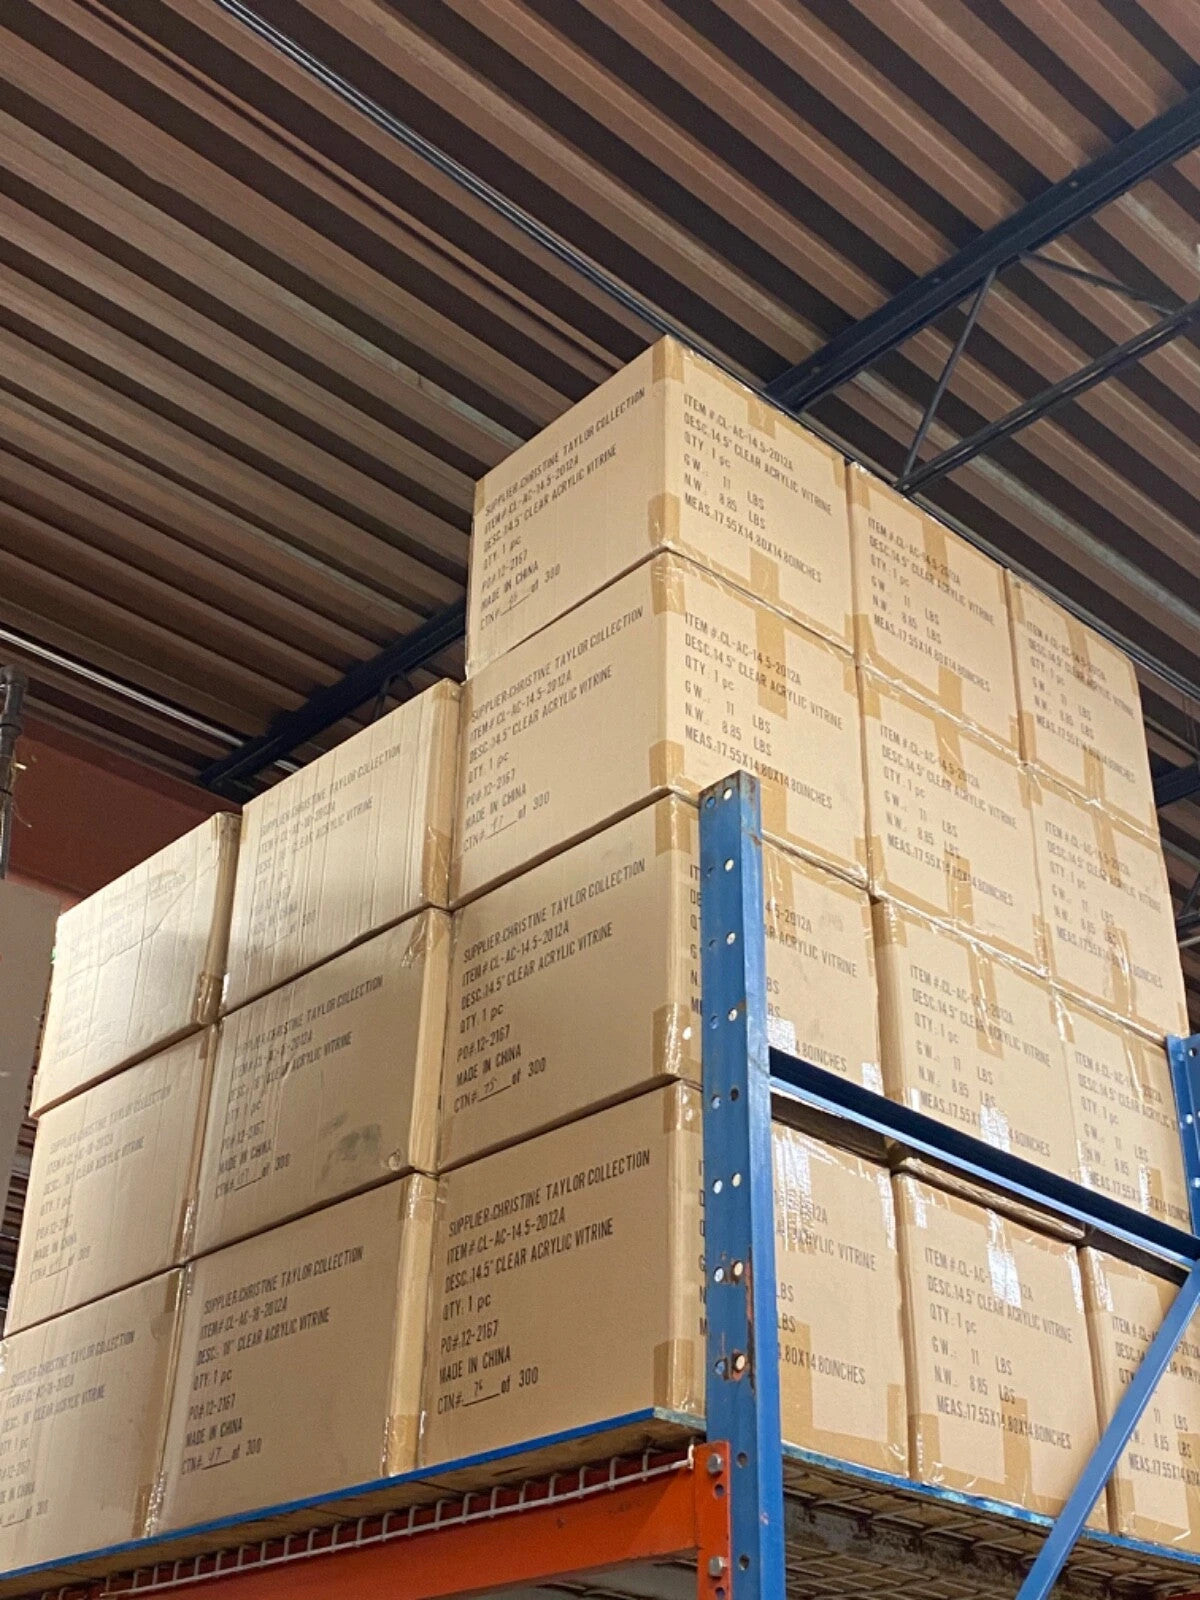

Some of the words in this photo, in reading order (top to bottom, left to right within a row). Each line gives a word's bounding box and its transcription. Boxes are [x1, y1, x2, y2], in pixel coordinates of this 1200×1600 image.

[563, 424, 593, 456] TAYLOR
[596, 386, 644, 431] COLLECTION
[524, 493, 548, 521] CLEAR
[552, 467, 584, 500] ACRYLIC
[587, 443, 616, 474] VITRINE
[722, 475, 730, 489] 11
[747, 490, 764, 510] LBS
[734, 443, 760, 469] CLEAR
[764, 462, 797, 493] ACRYLIC
[801, 486, 831, 516] VITRINE
[748, 509, 765, 529] LBS
[503, 579, 511, 593] IN
[515, 559, 538, 585] CHINA
[555, 639, 587, 669] TAYLOR
[590, 605, 642, 647] COLLECTION
[512, 709, 538, 735] CLEAR
[542, 686, 576, 717] ACRYLIC
[579, 664, 612, 695] VITRINE
[738, 661, 766, 687] CLEAR
[770, 679, 806, 709] ACRYLIC
[810, 702, 842, 730] VITRINE
[726, 701, 733, 714] 11
[752, 714, 770, 734] LBS
[753, 736, 771, 756] LBS
[465, 807, 484, 829] MADE
[490, 799, 497, 814] IN
[502, 783, 525, 806] CHINA
[942, 820, 957, 838] LBS
[551, 887, 586, 917] TAYLOR
[589, 857, 644, 898] COLLECTION
[506, 959, 535, 985] CLEAR
[538, 940, 574, 969] ACRYLIC
[578, 921, 612, 950] VITRINE
[778, 930, 817, 959] ACRYLIC
[821, 948, 857, 977] VITRINE
[337, 974, 383, 1007] COLLECTION
[490, 1002, 503, 1020] pc
[323, 1032, 351, 1056] VITRINE
[456, 1064, 478, 1086] MADE
[482, 1058, 491, 1074] IN
[495, 1043, 521, 1067] CHINA
[546, 1172, 584, 1199] TAYLOR
[587, 1148, 649, 1184] COLLECTION
[495, 1248, 526, 1273] CLEAR
[531, 1232, 572, 1260] ACRYLIC
[575, 1217, 613, 1246] VITRINE
[838, 1242, 877, 1272] VITRINE
[280, 1262, 313, 1286] TAYLOR
[313, 1245, 363, 1275] COLLECTION
[477, 1292, 491, 1312] pc
[977, 1294, 1004, 1316] CLEAR
[1006, 1304, 1040, 1330] ACRYLIC
[1042, 1318, 1072, 1343] VITRINE
[237, 1329, 263, 1350] CLEAR
[264, 1318, 296, 1341] ACRYLIC
[298, 1307, 330, 1330] VITRINE
[965, 1318, 976, 1335] pc
[439, 1360, 462, 1383] MADE
[467, 1356, 477, 1373] IN
[482, 1345, 510, 1368] CHINA
[500, 1375, 510, 1393] of
[518, 1366, 538, 1387] 300
[970, 1349, 979, 1365] 11
[995, 1356, 1012, 1375] LBS
[998, 1384, 1015, 1403] LBS
[185, 1429, 205, 1447] MADE
[219, 1417, 242, 1436] CHINA
